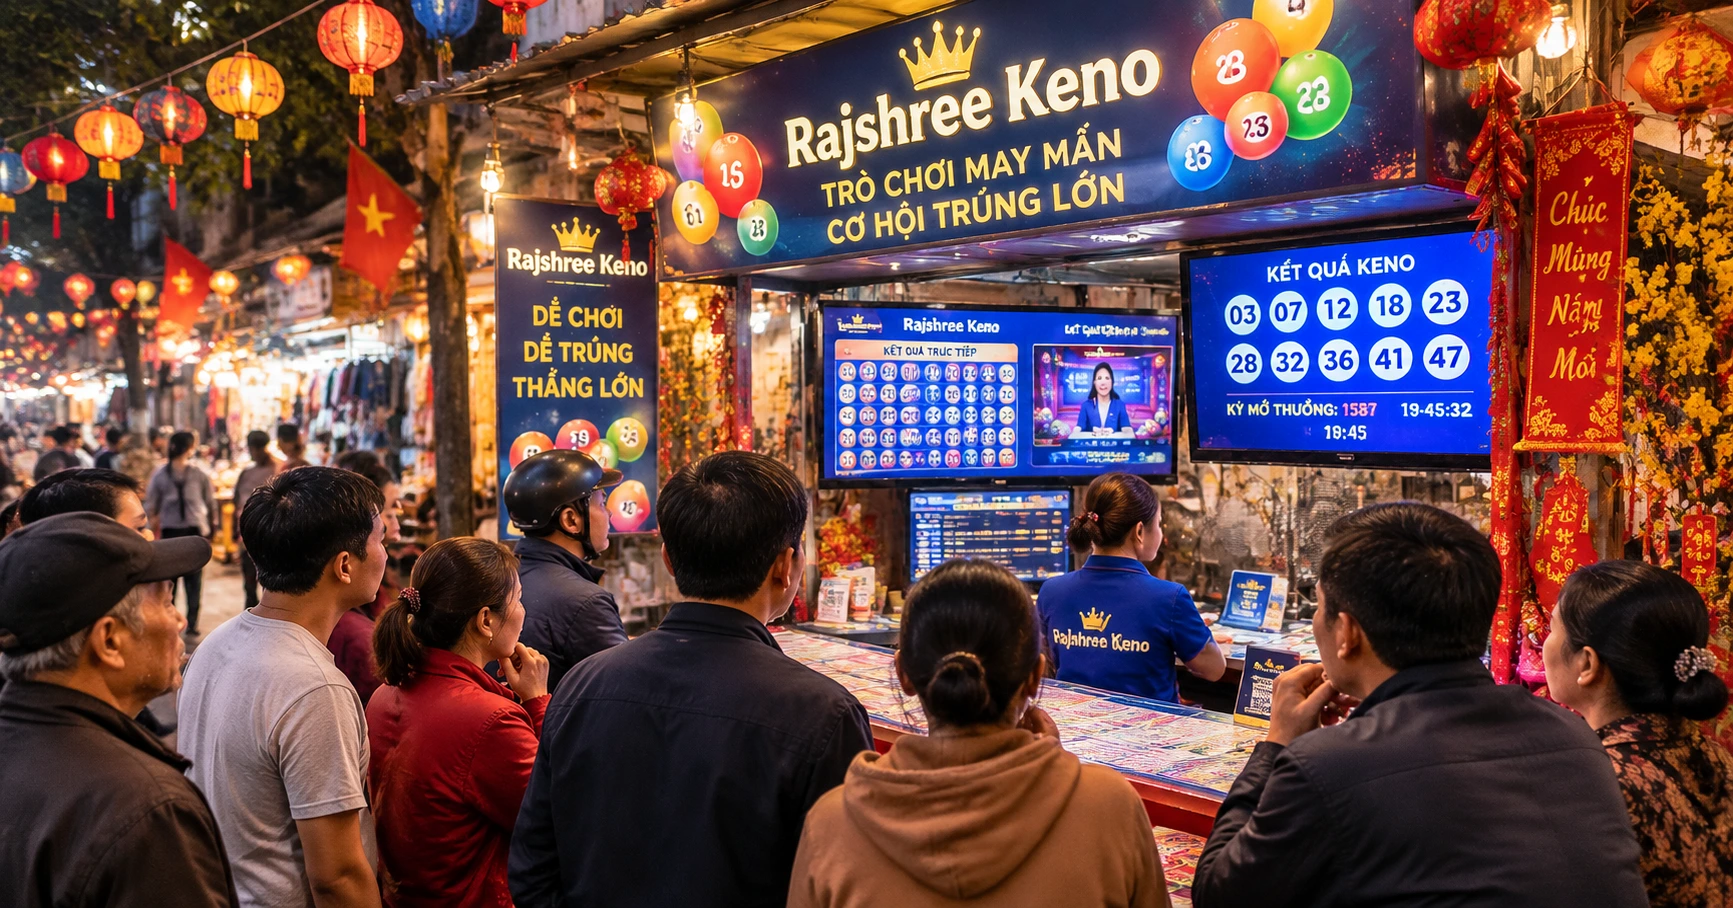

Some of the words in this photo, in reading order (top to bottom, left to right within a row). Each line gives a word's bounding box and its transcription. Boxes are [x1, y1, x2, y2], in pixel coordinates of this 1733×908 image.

[785, 87, 993, 170] Rajshree
[1005, 49, 1162, 122] Keno
[821, 170, 875, 208] TRÒ
[884, 159, 955, 197] CHƠI
[965, 145, 1031, 183] MAY
[827, 213, 865, 245] CƠ
[875, 201, 925, 241] HỘI
[1053, 169, 1125, 212] LỚN
[506, 247, 596, 276] Rajshree
[600, 253, 648, 277] Keno
[1358, 254, 1415, 276] KENO
[1230, 304, 1257, 325] 03
[1274, 301, 1302, 322] 07
[1324, 297, 1352, 320] 12
[1375, 294, 1404, 317] 18
[1428, 290, 1462, 314] 23
[903, 317, 964, 334] Rajshree
[1231, 353, 1258, 374] 28
[1275, 351, 1304, 373] 32
[1324, 349, 1354, 371] 36
[1375, 347, 1404, 370] 41
[1428, 345, 1463, 369] 47
[1342, 402, 1378, 417] 1587
[1401, 402, 1473, 418] 19-45:32
